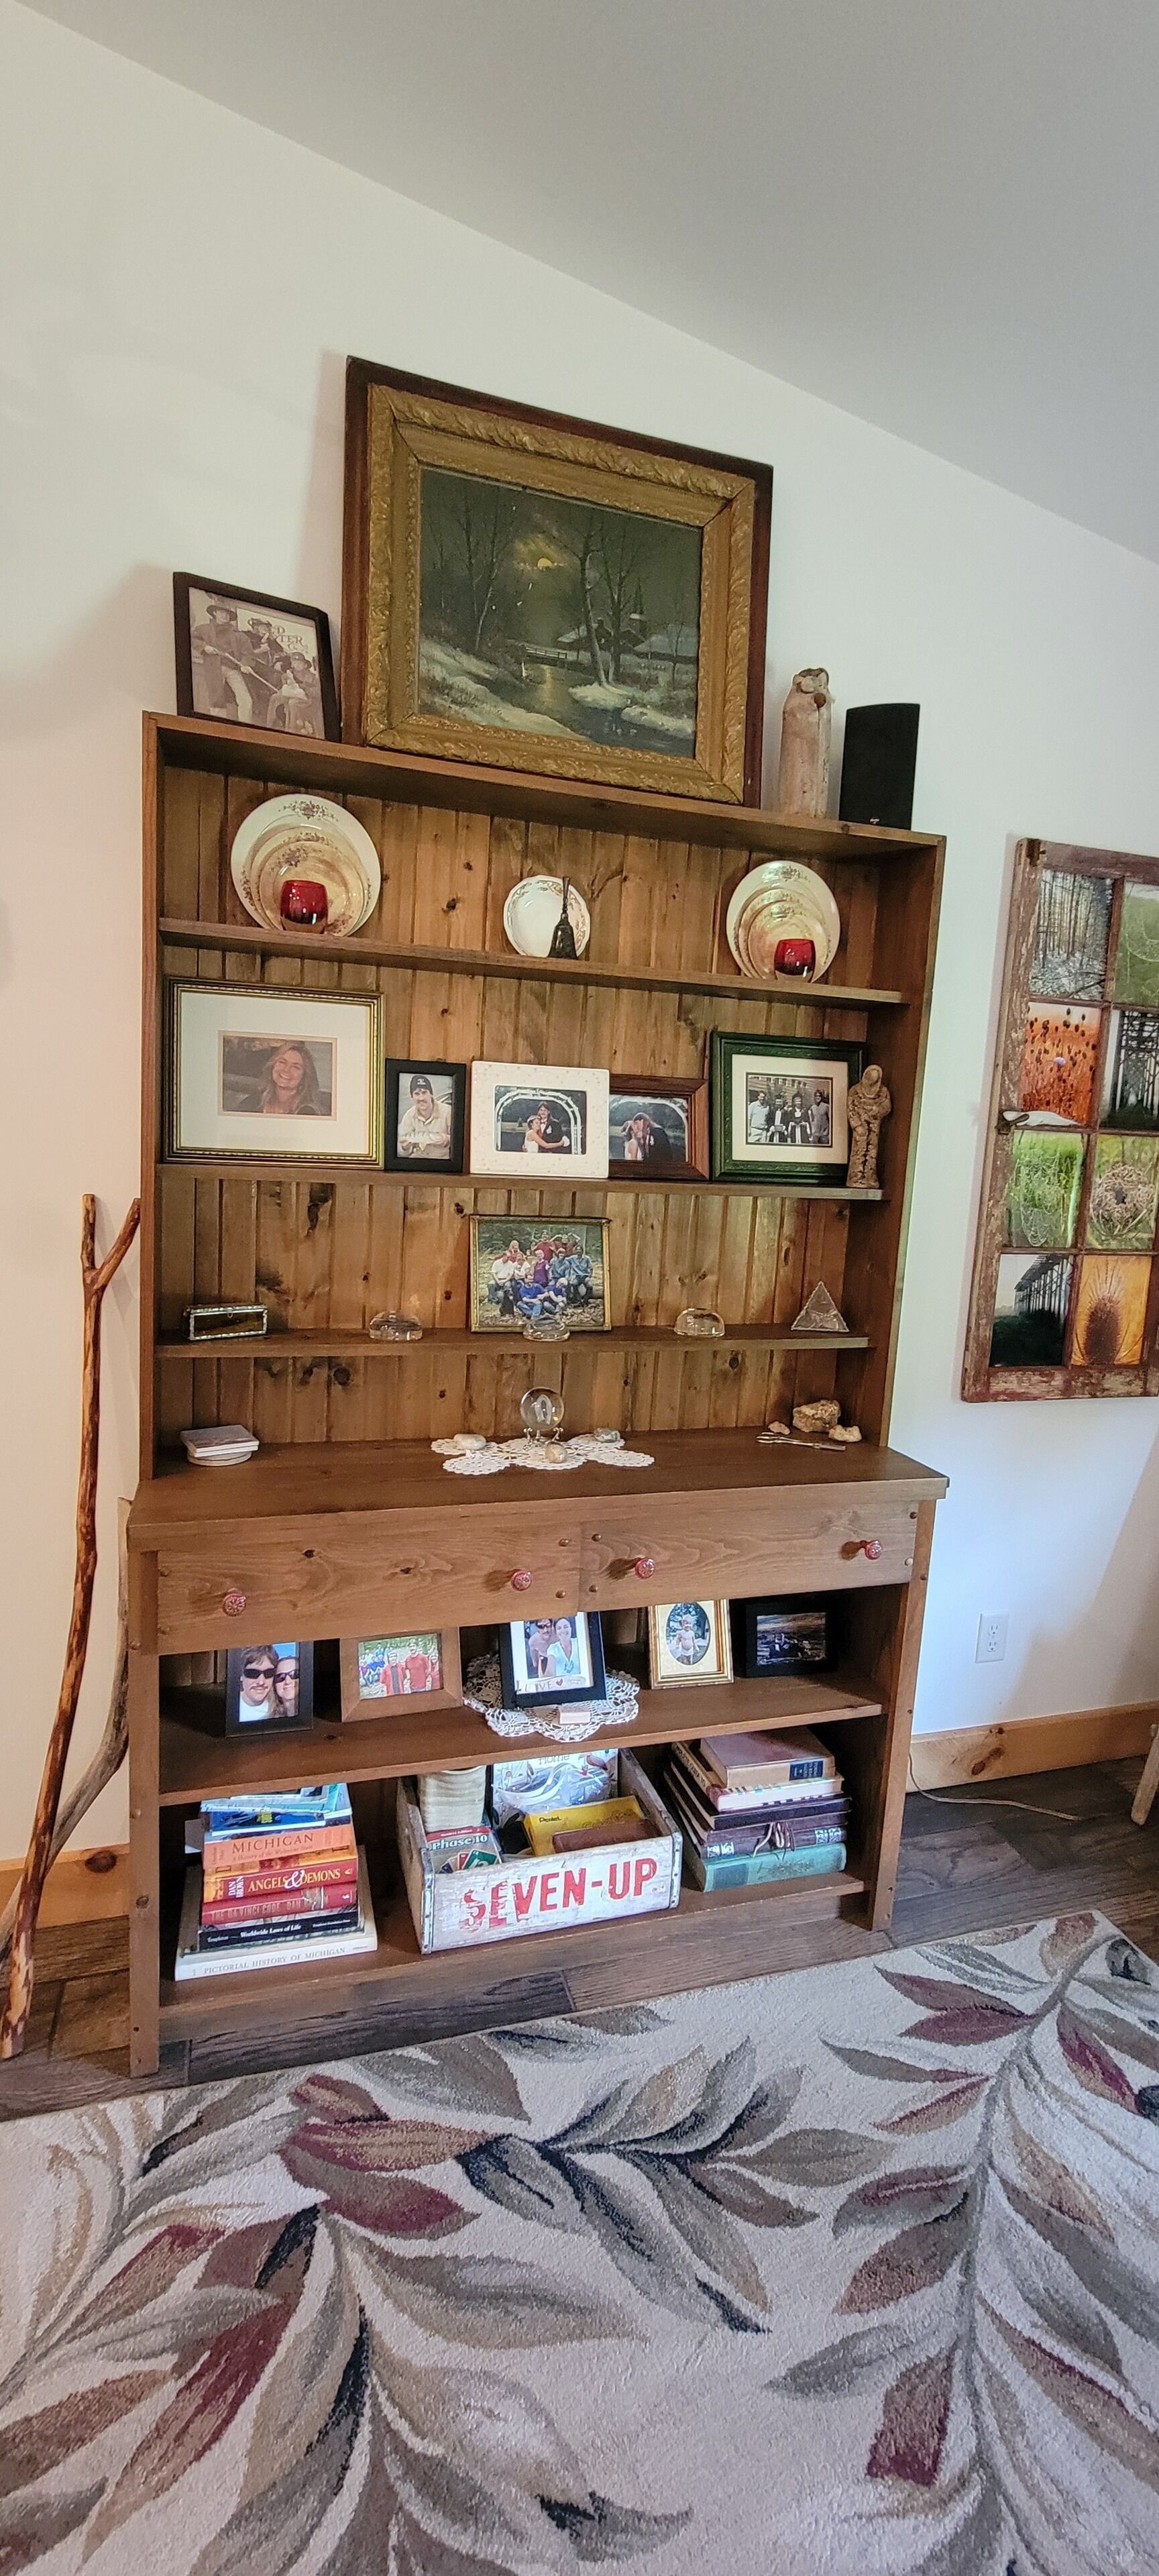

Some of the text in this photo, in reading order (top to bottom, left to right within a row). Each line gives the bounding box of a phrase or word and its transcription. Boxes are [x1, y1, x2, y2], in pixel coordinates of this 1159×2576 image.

[232, 1833, 314, 1854] MICHIGAN
[431, 1833, 488, 1850] Phase 10
[228, 1880, 236, 1896] DAN
[235, 1876, 244, 1899] BROWN
[247, 1868, 341, 1892] ANGELS & DEMONS
[459, 1857, 657, 1933] SEVEN-UP
[212, 1900, 301, 1919] THE DA VINCI CODE DAN
[204, 1962, 249, 1974] PICTORIAL
[252, 1956, 287, 1968] HISTORY
[290, 1953, 302, 1962] OF
[305, 1947, 345, 1959] MICHIGAN
